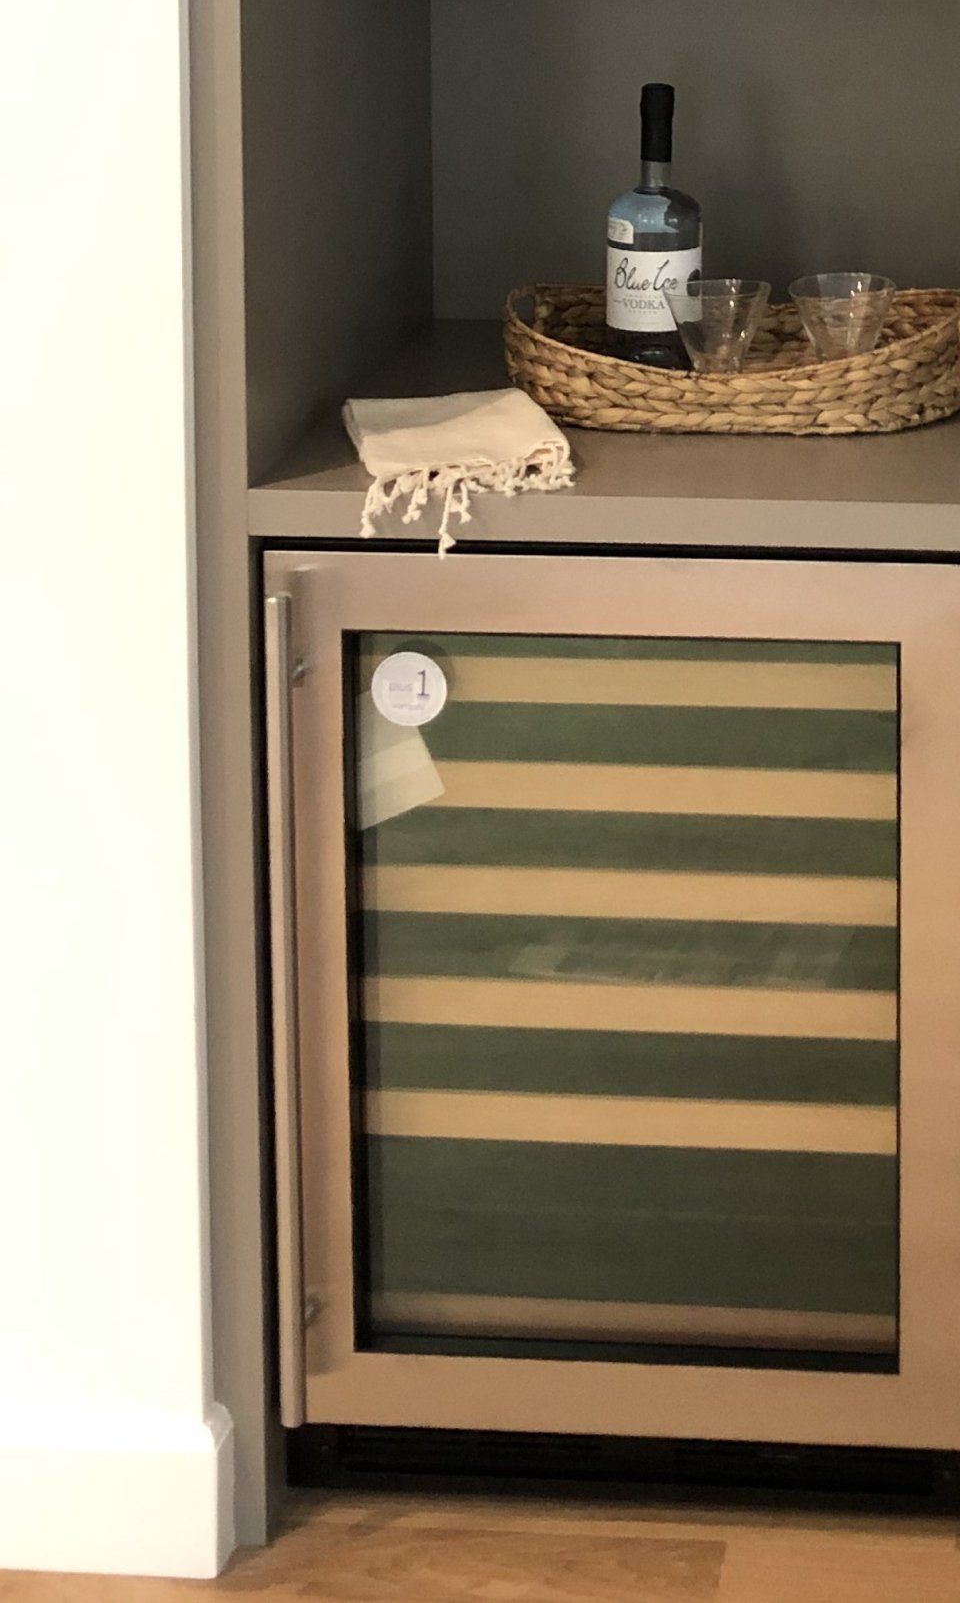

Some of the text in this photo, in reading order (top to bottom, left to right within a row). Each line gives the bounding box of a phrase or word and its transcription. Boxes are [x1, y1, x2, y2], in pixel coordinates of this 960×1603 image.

[614, 257, 678, 291] Blue Ice
[622, 297, 666, 310] VODKA
[416, 669, 430, 696] 1
